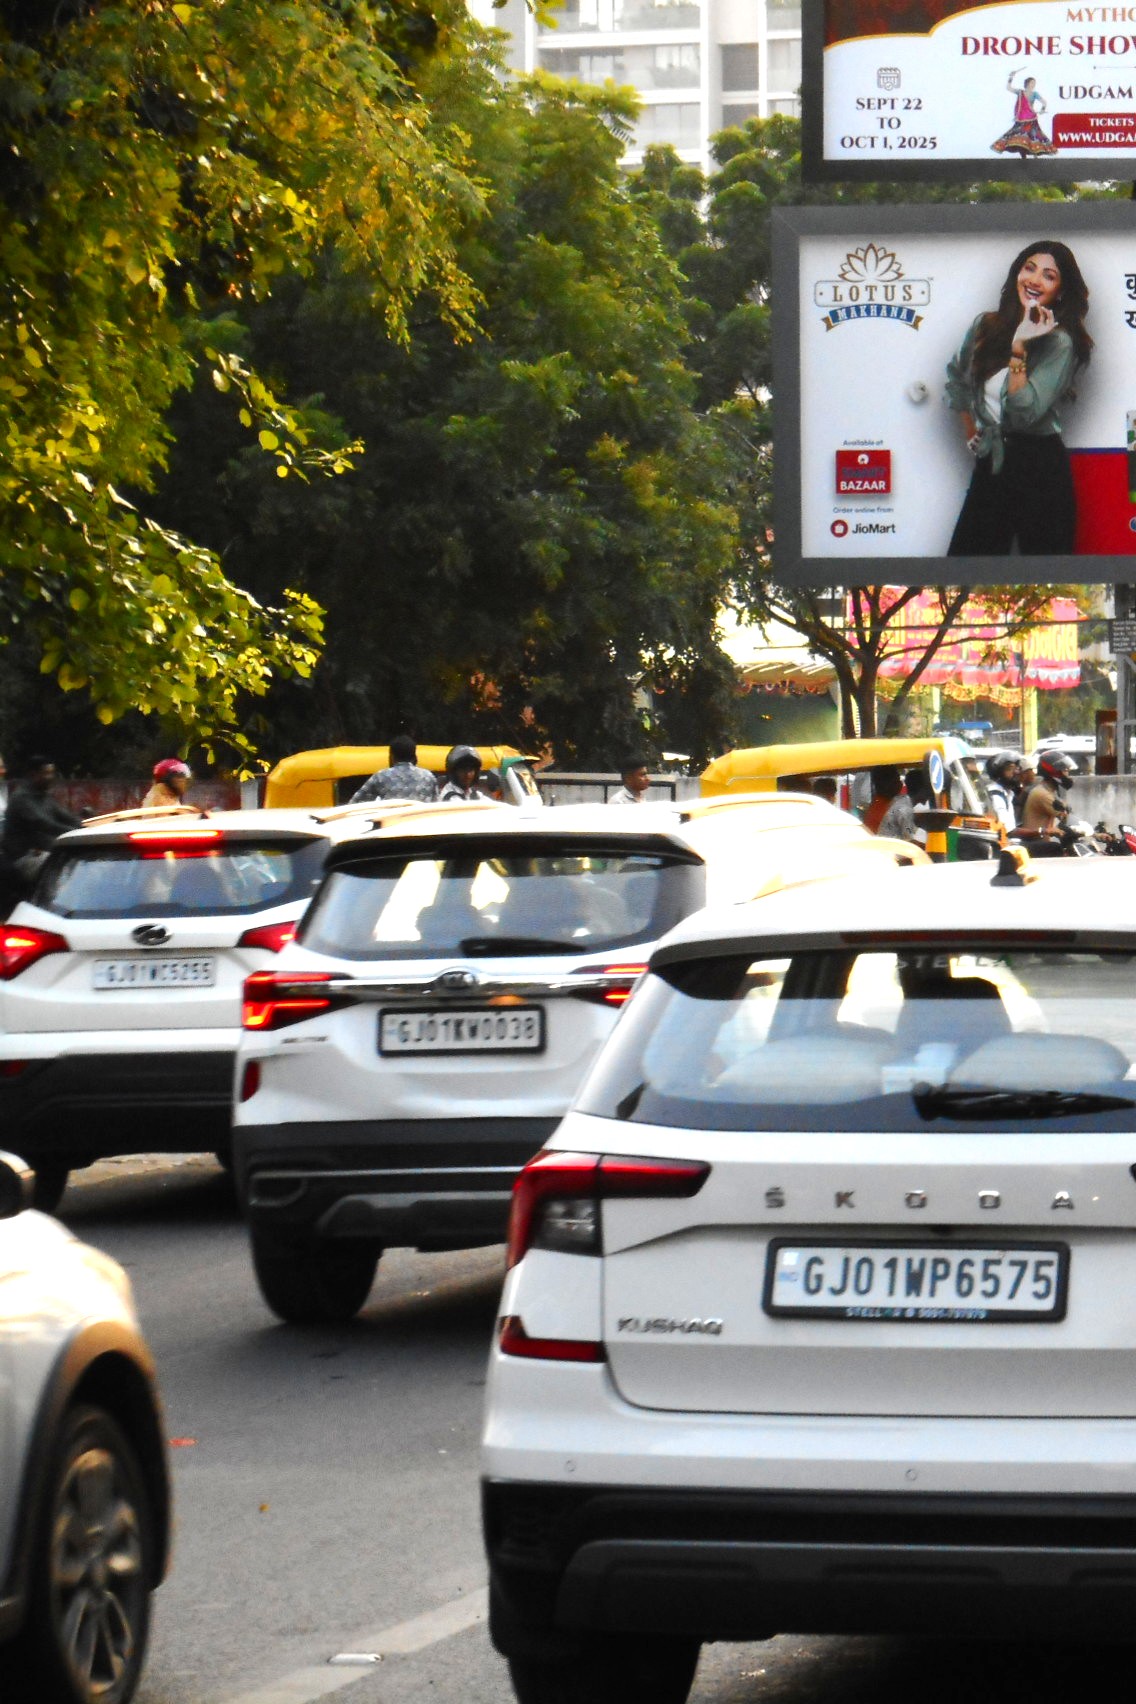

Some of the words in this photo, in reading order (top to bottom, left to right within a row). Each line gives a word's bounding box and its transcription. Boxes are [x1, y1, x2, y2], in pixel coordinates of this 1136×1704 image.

[960, 35, 1062, 57] DRONE
[1058, 86, 1133, 100] UDGAM
[855, 97, 899, 111] SEPT
[902, 97, 923, 111] 22
[876, 116, 902, 130] TO
[1089, 117, 1134, 128] TICKETS
[840, 136, 879, 150] OCT
[897, 136, 938, 150] 2025
[832, 284, 913, 302] LOTUS
[836, 304, 908, 321] MAKHANA
[840, 480, 886, 491] BAZAAR
[851, 523, 896, 534] JioMart
[803, 1254, 1058, 1302] GJ01WP6575
